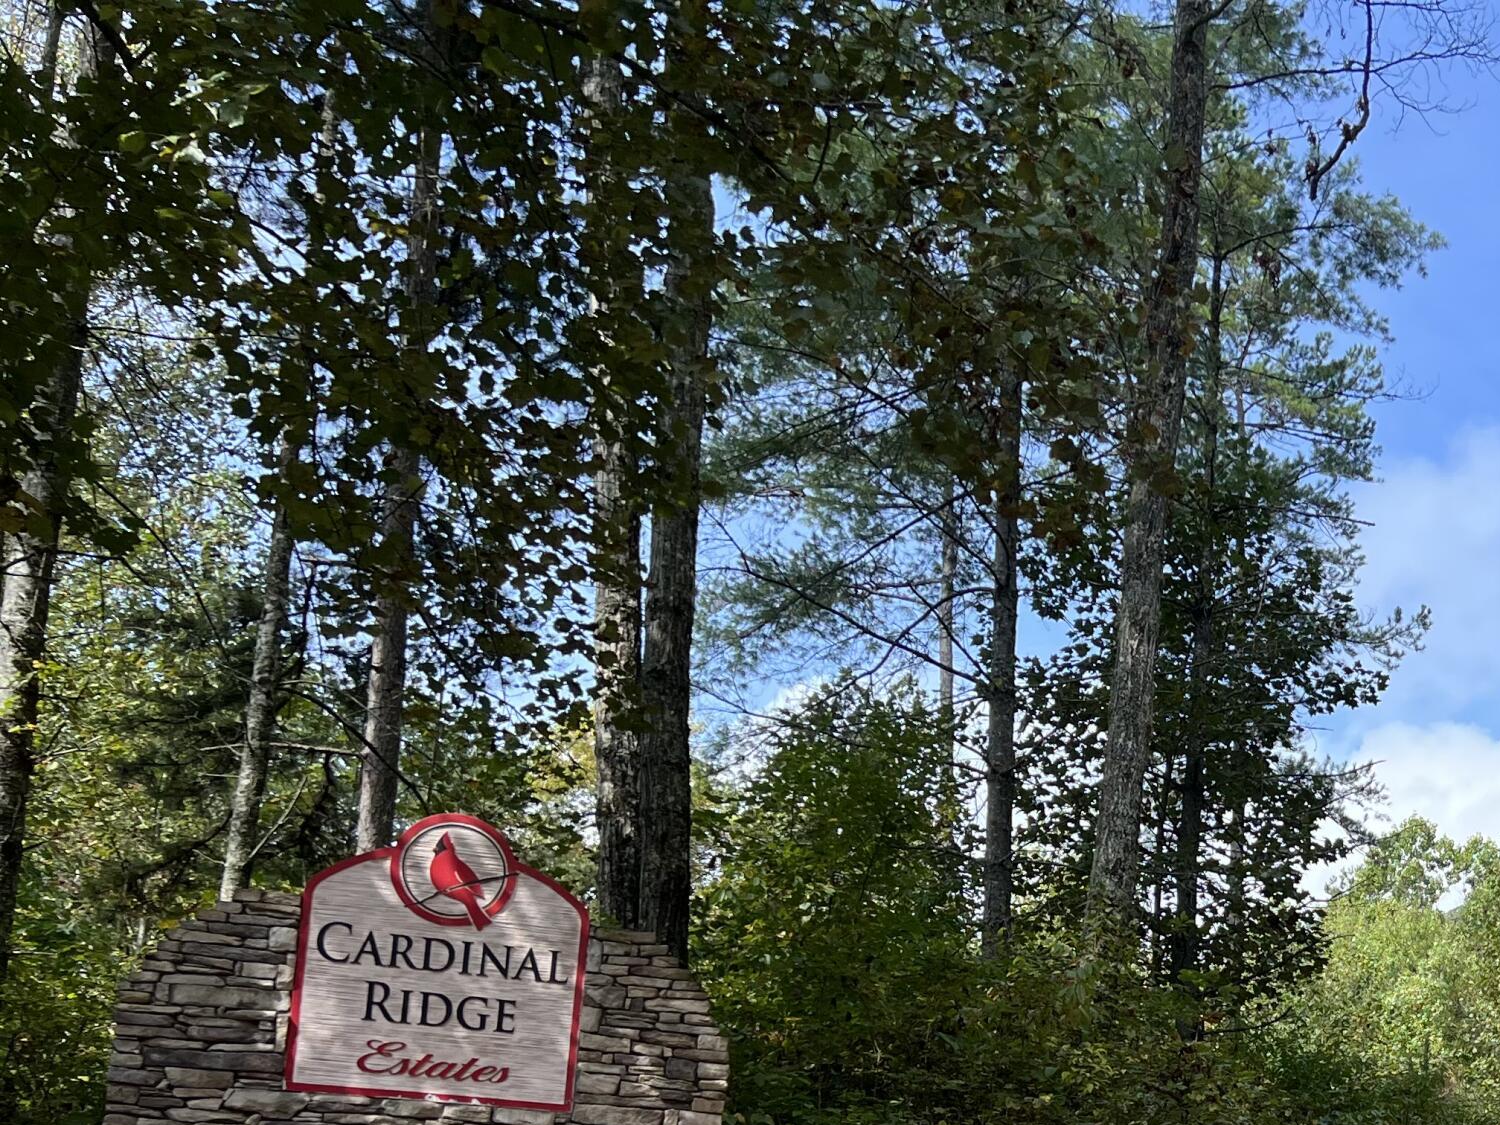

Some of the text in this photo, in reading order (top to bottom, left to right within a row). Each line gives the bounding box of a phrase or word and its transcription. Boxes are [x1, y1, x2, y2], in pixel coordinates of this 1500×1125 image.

[316, 921, 569, 985] CARDINAL
[360, 980, 517, 1034] RIDGE
[356, 1039, 510, 1084] Estates
